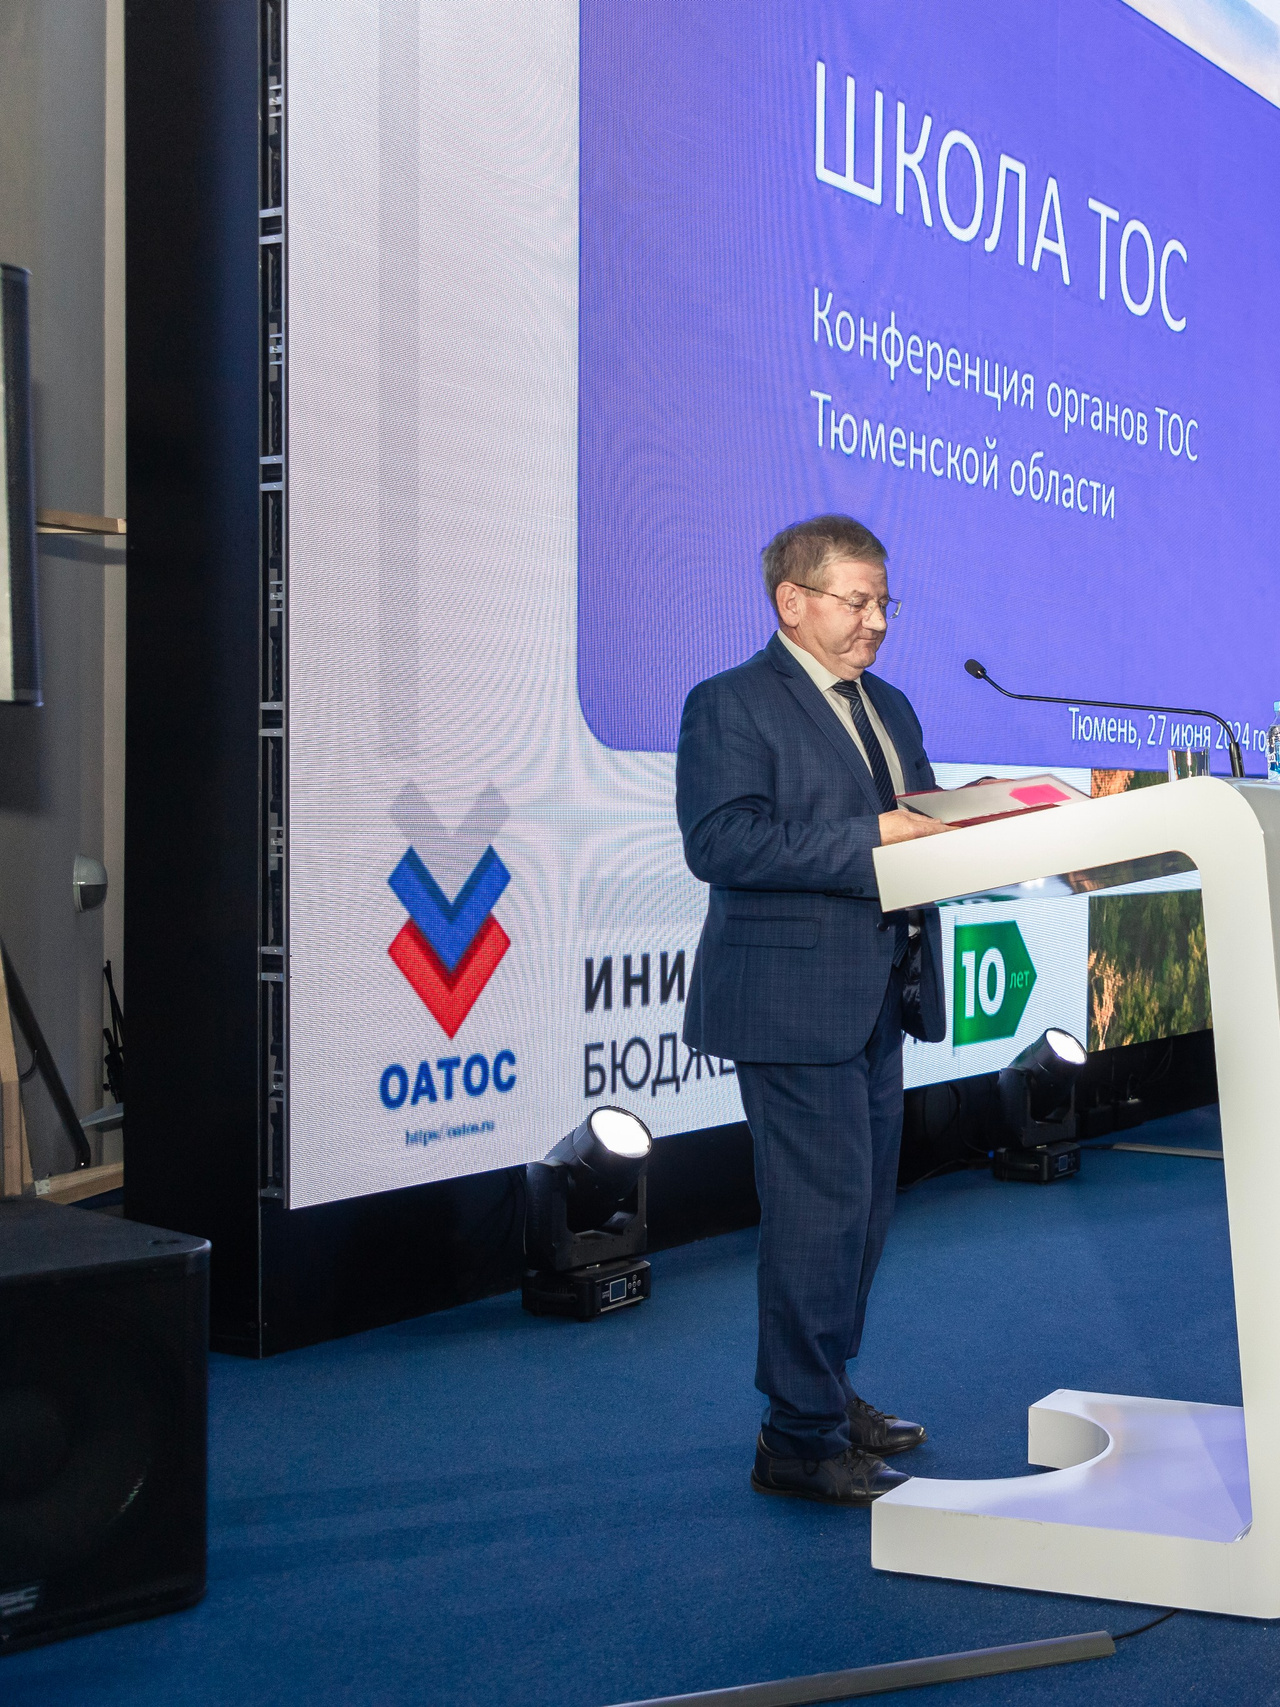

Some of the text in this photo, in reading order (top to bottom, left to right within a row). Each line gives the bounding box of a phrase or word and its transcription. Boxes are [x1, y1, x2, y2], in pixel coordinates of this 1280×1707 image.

[815, 60, 1189, 333] ШКОЛА ТОС
[812, 287, 1199, 461] Конференция органов ТОС
[810, 390, 1116, 519] Тюменской области
[1068, 706, 1142, 750] Тюмень,
[1147, 714, 1167, 746] 27
[1171, 722, 1211, 749] июня
[1215, 720, 1250, 751] 2024
[584, 949, 686, 1014] ИНИ
[962, 946, 1030, 1020] 10 лет
[380, 1049, 517, 1110] ОАТОС
